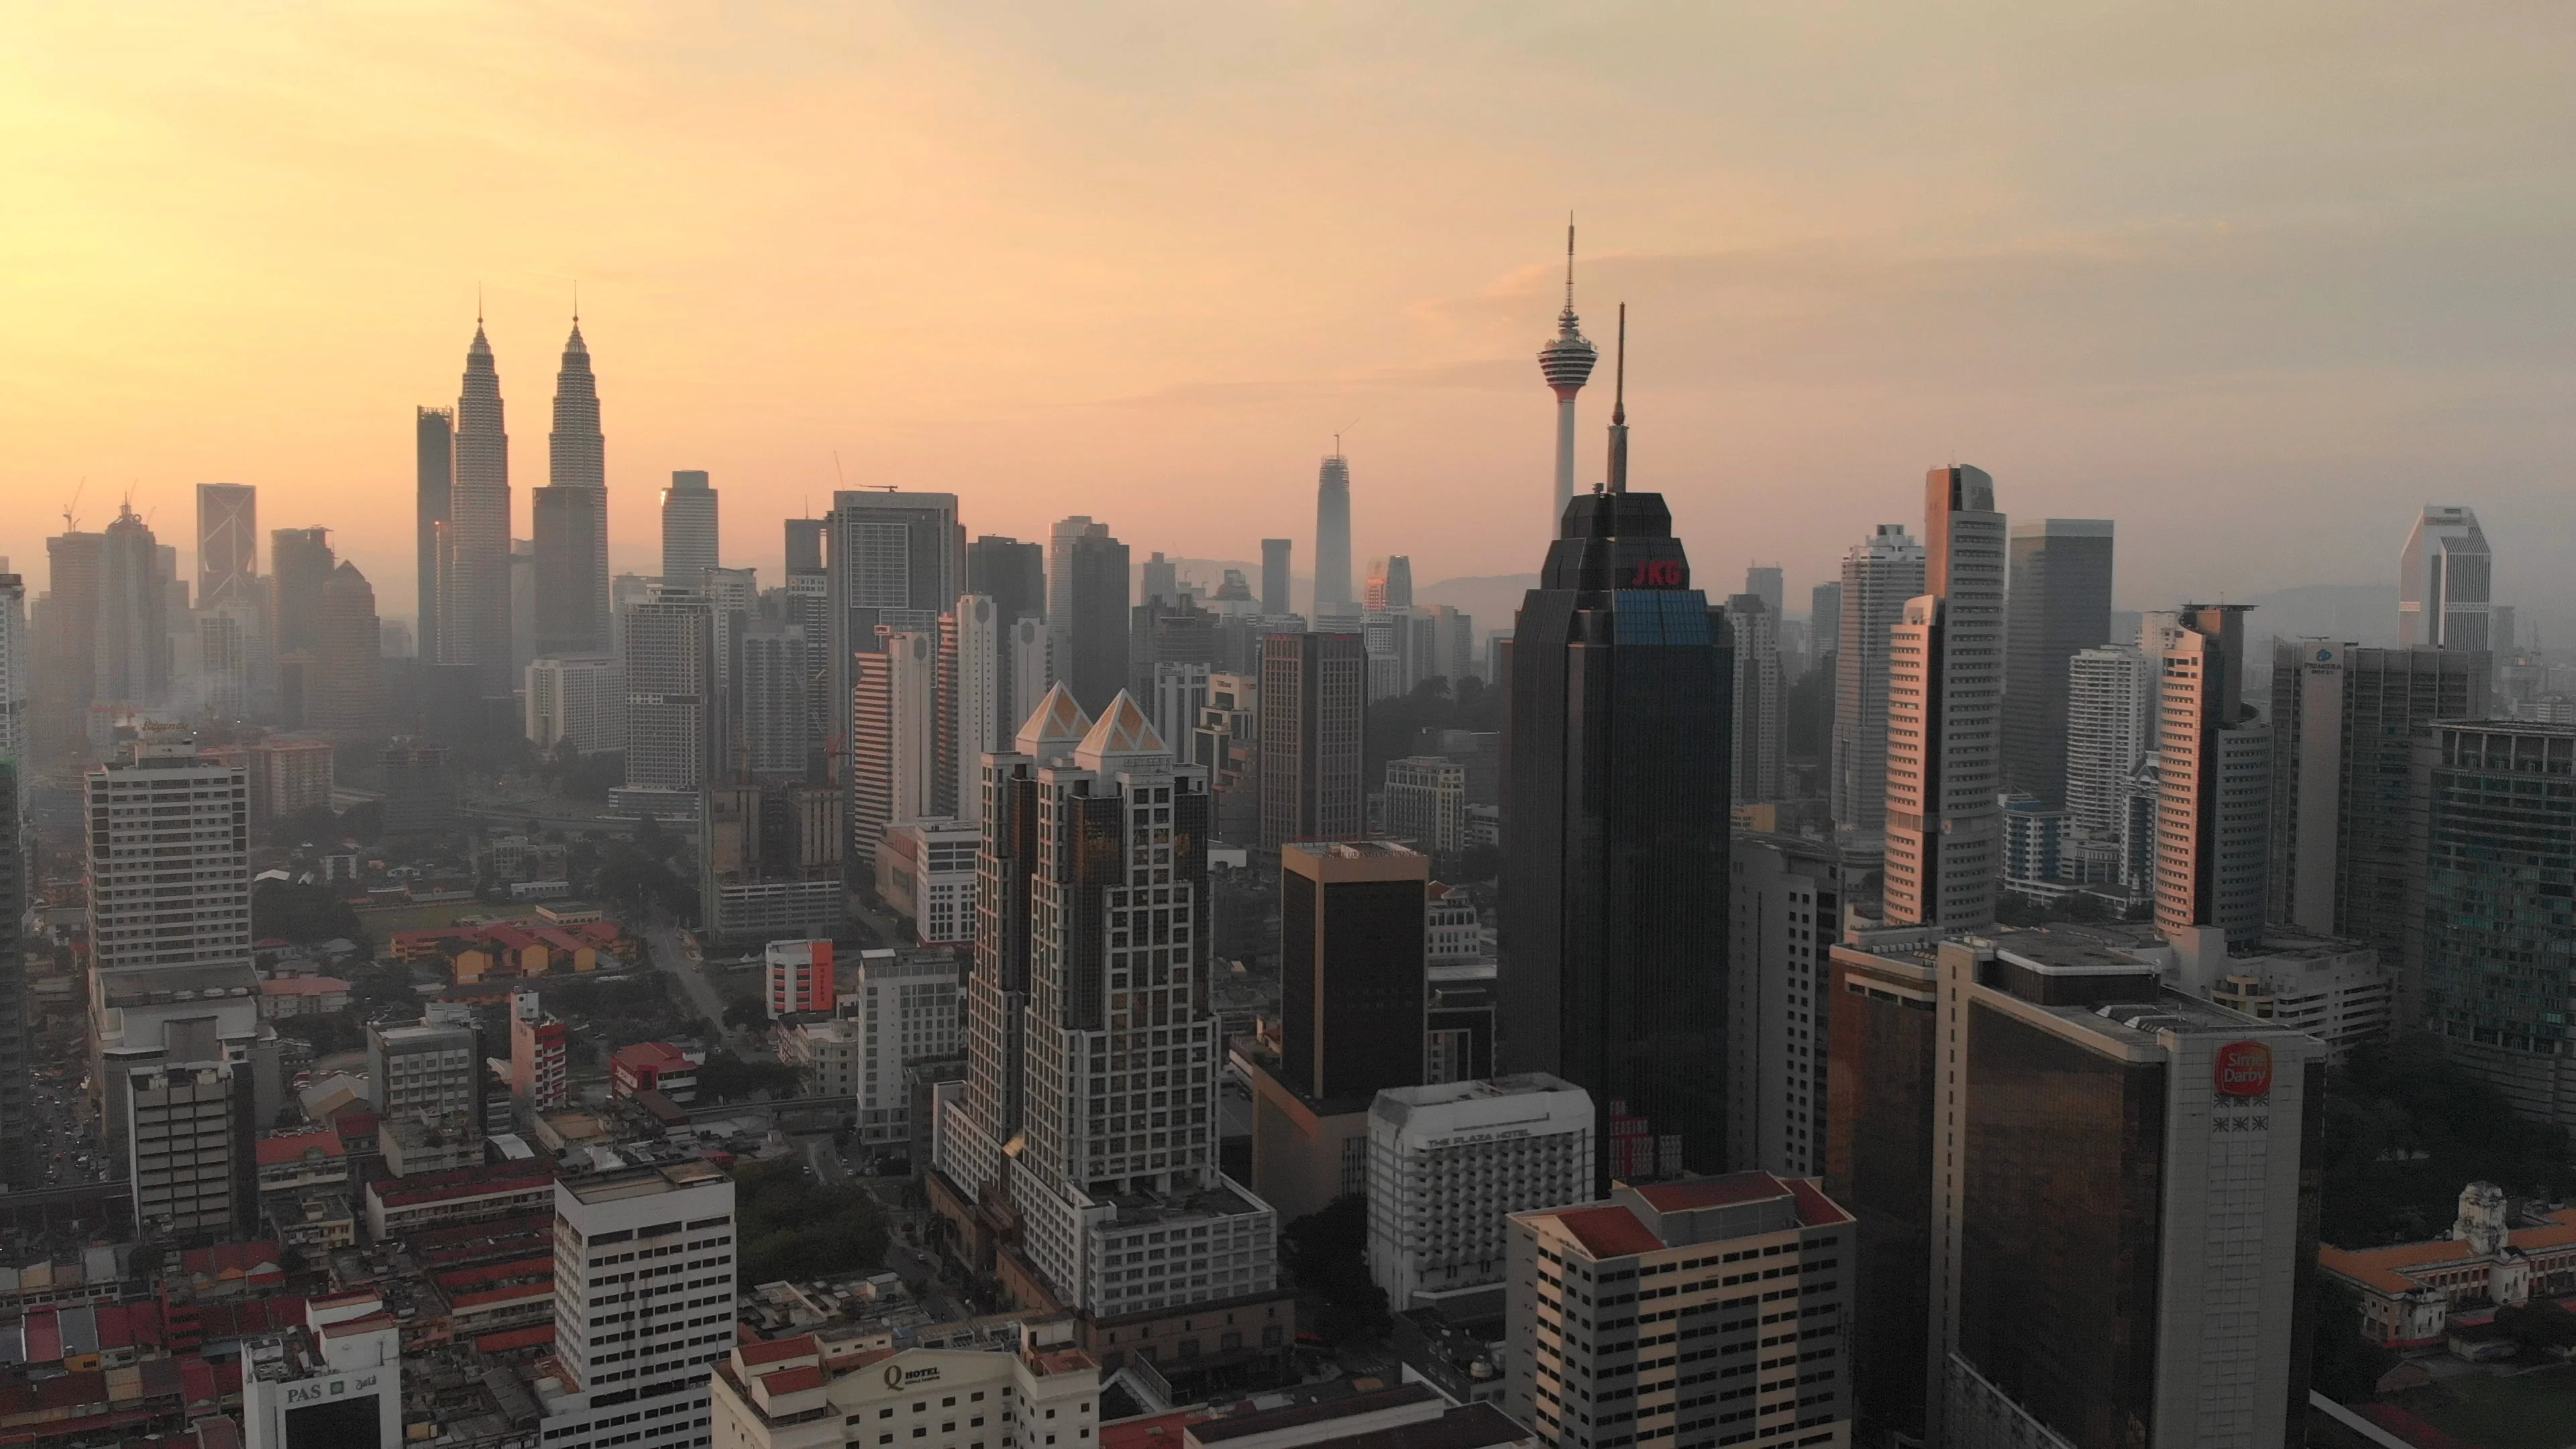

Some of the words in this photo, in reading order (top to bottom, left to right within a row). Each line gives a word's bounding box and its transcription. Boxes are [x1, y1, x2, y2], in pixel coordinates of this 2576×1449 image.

[1631, 559, 1681, 586] JKG
[1348, 851, 1373, 859] GRAND
[2229, 1053, 2263, 1067] Sime
[2224, 1067, 2266, 1086] Darby
[1609, 1100, 1626, 1115] FOR
[1609, 1119, 1648, 1136] LEASING
[1428, 1138, 1450, 1147] THE
[1454, 1133, 1493, 1144] PLAZA
[1496, 1128, 1532, 1139] HOTEL
[1631, 1136, 1654, 1156] 2222
[884, 1365, 904, 1391] Q
[905, 1367, 940, 1379] HOTEL
[286, 1384, 321, 1403] PAS
